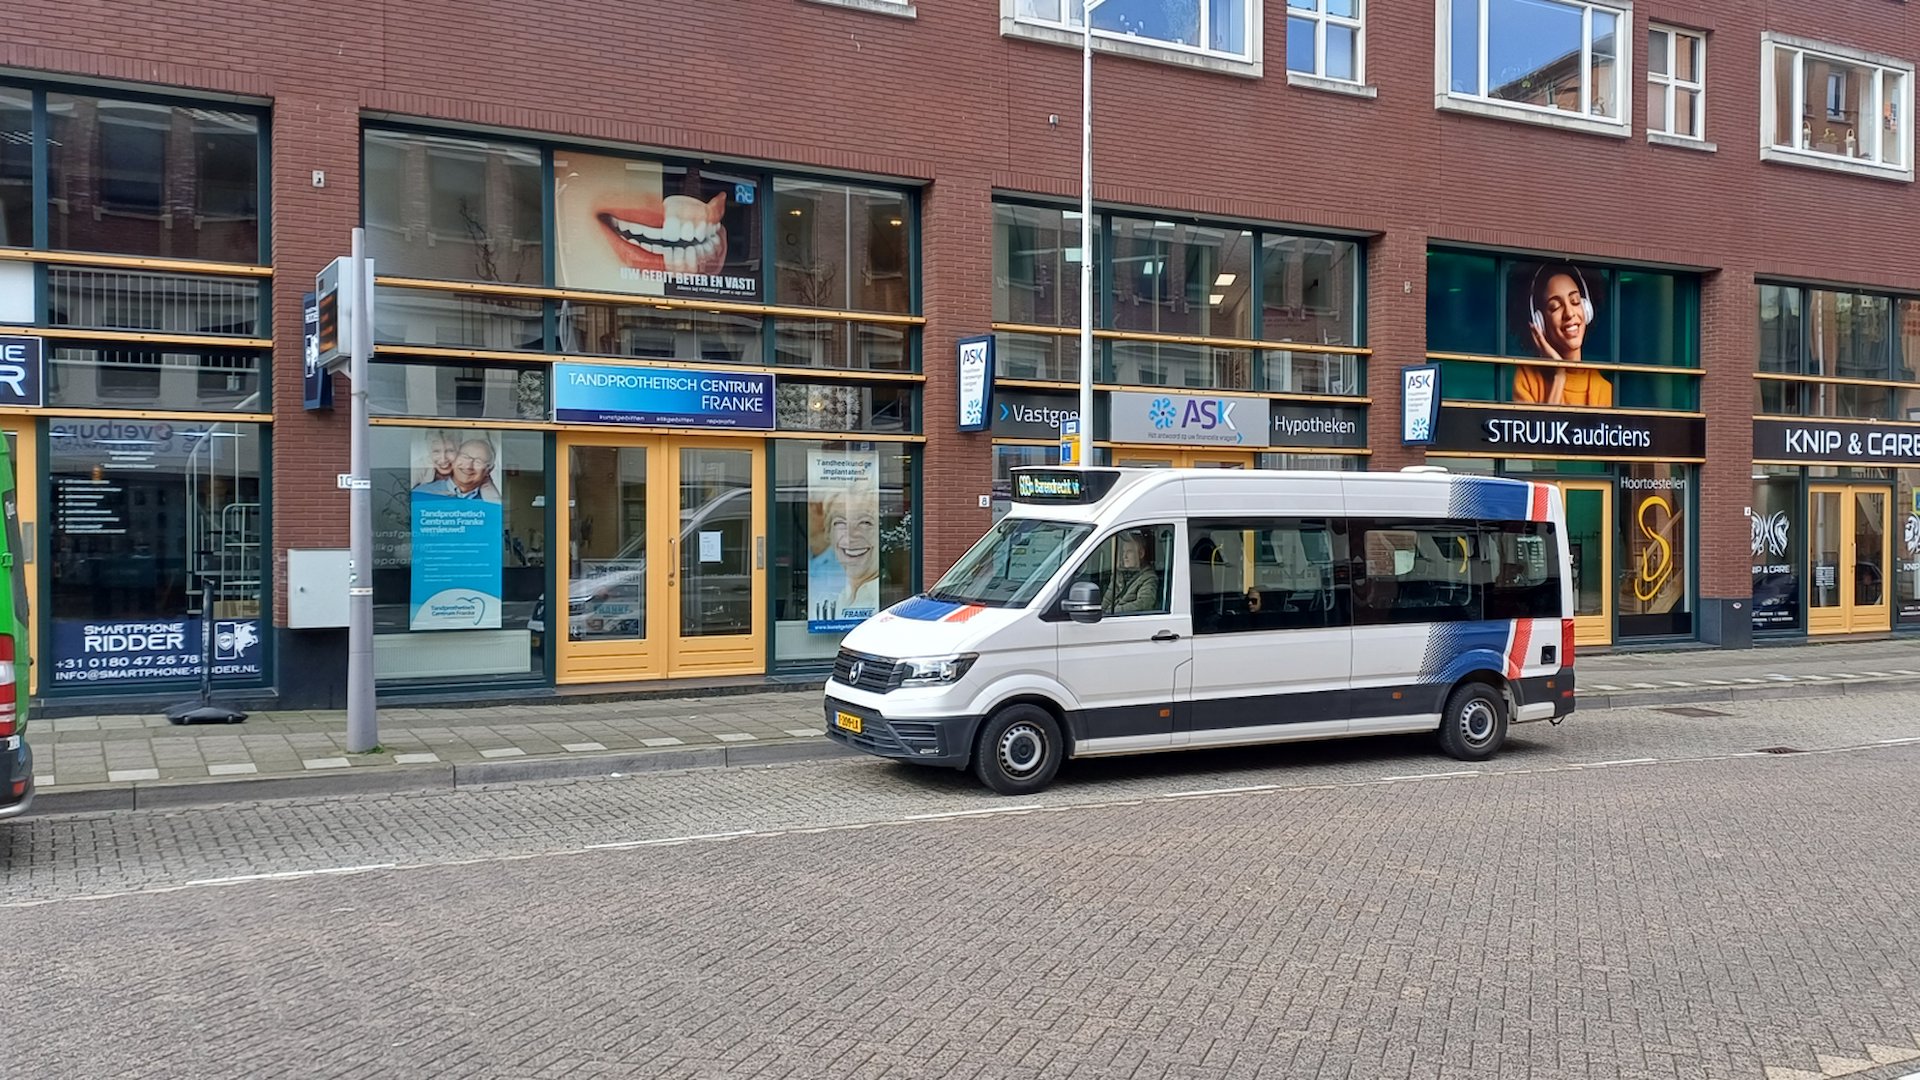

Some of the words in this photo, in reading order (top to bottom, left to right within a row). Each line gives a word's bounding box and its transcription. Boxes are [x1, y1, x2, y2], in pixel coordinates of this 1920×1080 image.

[642, 269, 673, 284] GEBIT
[676, 272, 708, 286] BETER
[710, 275, 723, 288] EN
[962, 347, 984, 366] ASK
[568, 372, 697, 391] TANDPROTHETISCH
[700, 379, 764, 394] CENTRUM
[1407, 374, 1431, 389] ASK
[702, 395, 763, 412] FRANKE
[1012, 404, 1080, 429] Vastgoe
[1181, 399, 1236, 431] ASK
[1274, 415, 1356, 436] Hypotheken
[1487, 418, 1570, 445] STRUIJK
[1572, 422, 1651, 448] audiciens
[1785, 428, 1842, 454] KNIP
[1847, 432, 1863, 455] &
[1034, 478, 1072, 494] Barendrecht
[1620, 476, 1687, 490] Hoortoestellen
[981, 496, 988, 506] 8
[420, 509, 486, 519] Tandprothetisch
[420, 518, 455, 526] Centrum
[456, 518, 485, 526] Franke
[1769, 564, 1790, 574] CARE
[843, 609, 874, 618] FRANKE
[84, 622, 185, 635] SMARTPHONE
[84, 633, 184, 653] RIDDER
[55, 656, 83, 669] +31
[89, 655, 130, 668] 0180
[133, 655, 153, 667] 47
[156, 654, 177, 666] 26
[179, 653, 200, 665] 78
